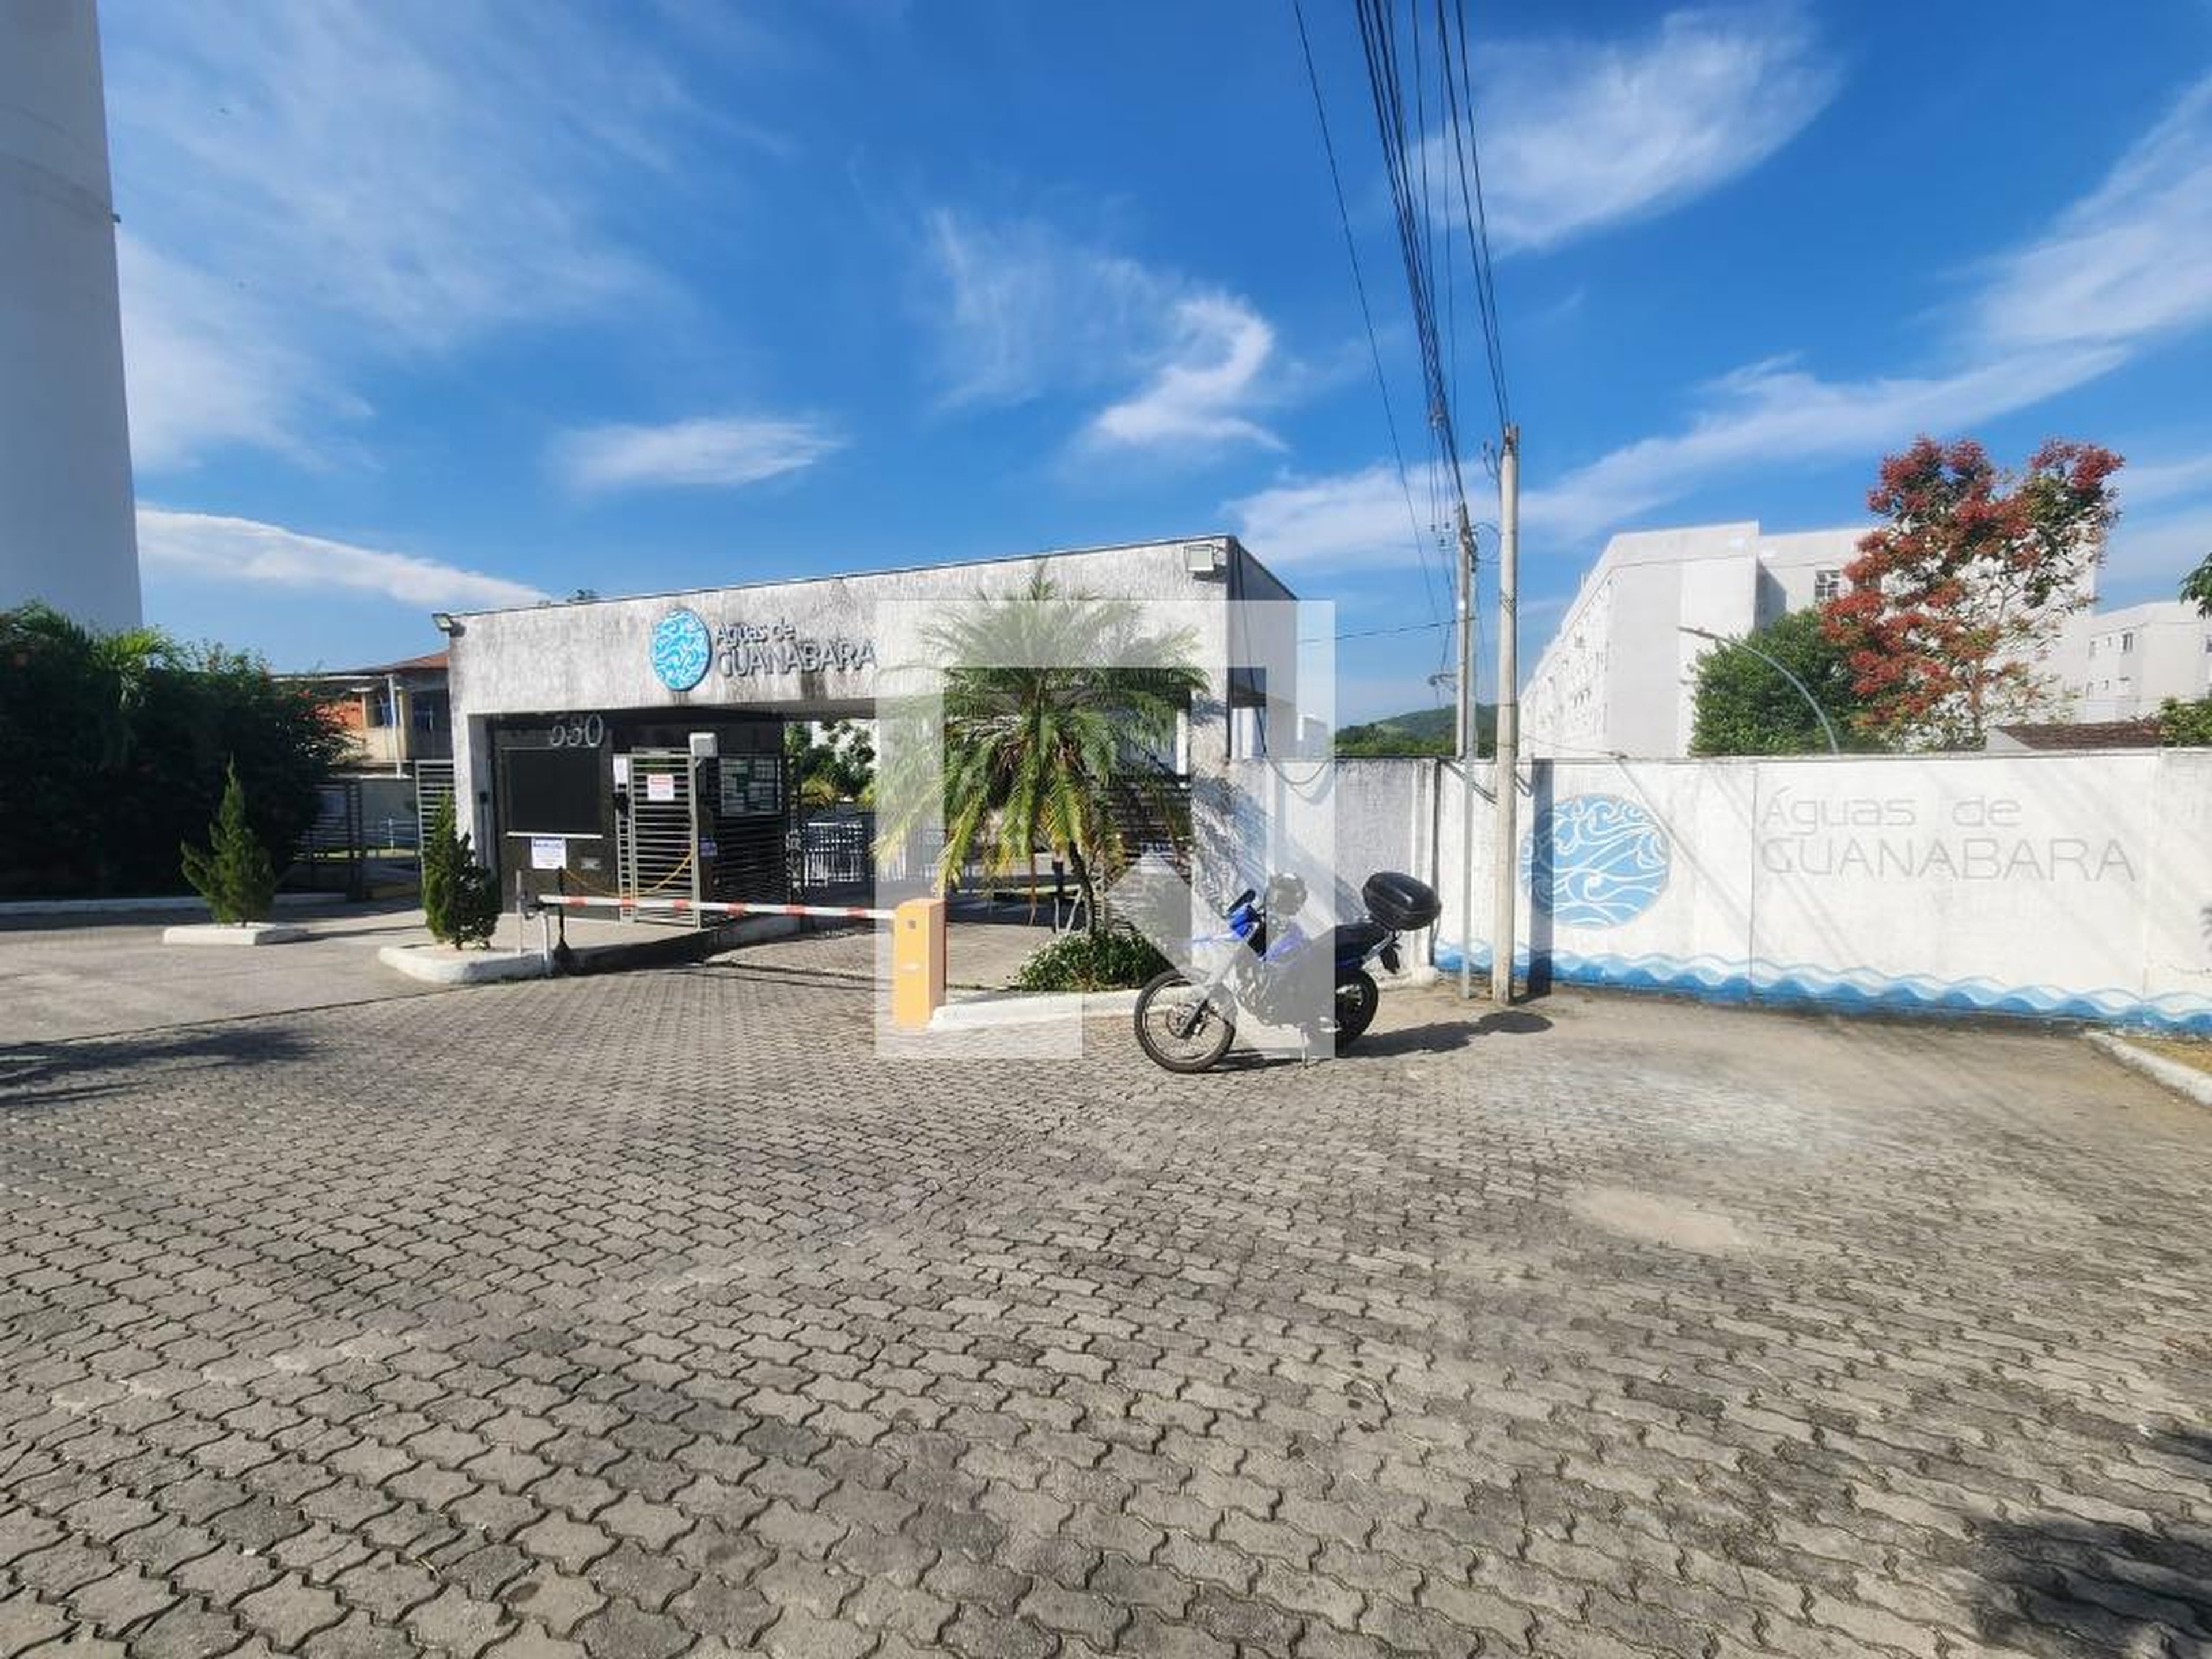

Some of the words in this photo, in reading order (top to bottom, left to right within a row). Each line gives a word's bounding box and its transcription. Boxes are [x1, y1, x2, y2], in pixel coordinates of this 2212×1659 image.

[772, 617, 796, 642] de
[719, 639, 877, 677] GUANABARA
[1761, 786, 1917, 835] Águas
[1952, 794, 2022, 827] de
[1760, 838, 2136, 882] GUANABARA
